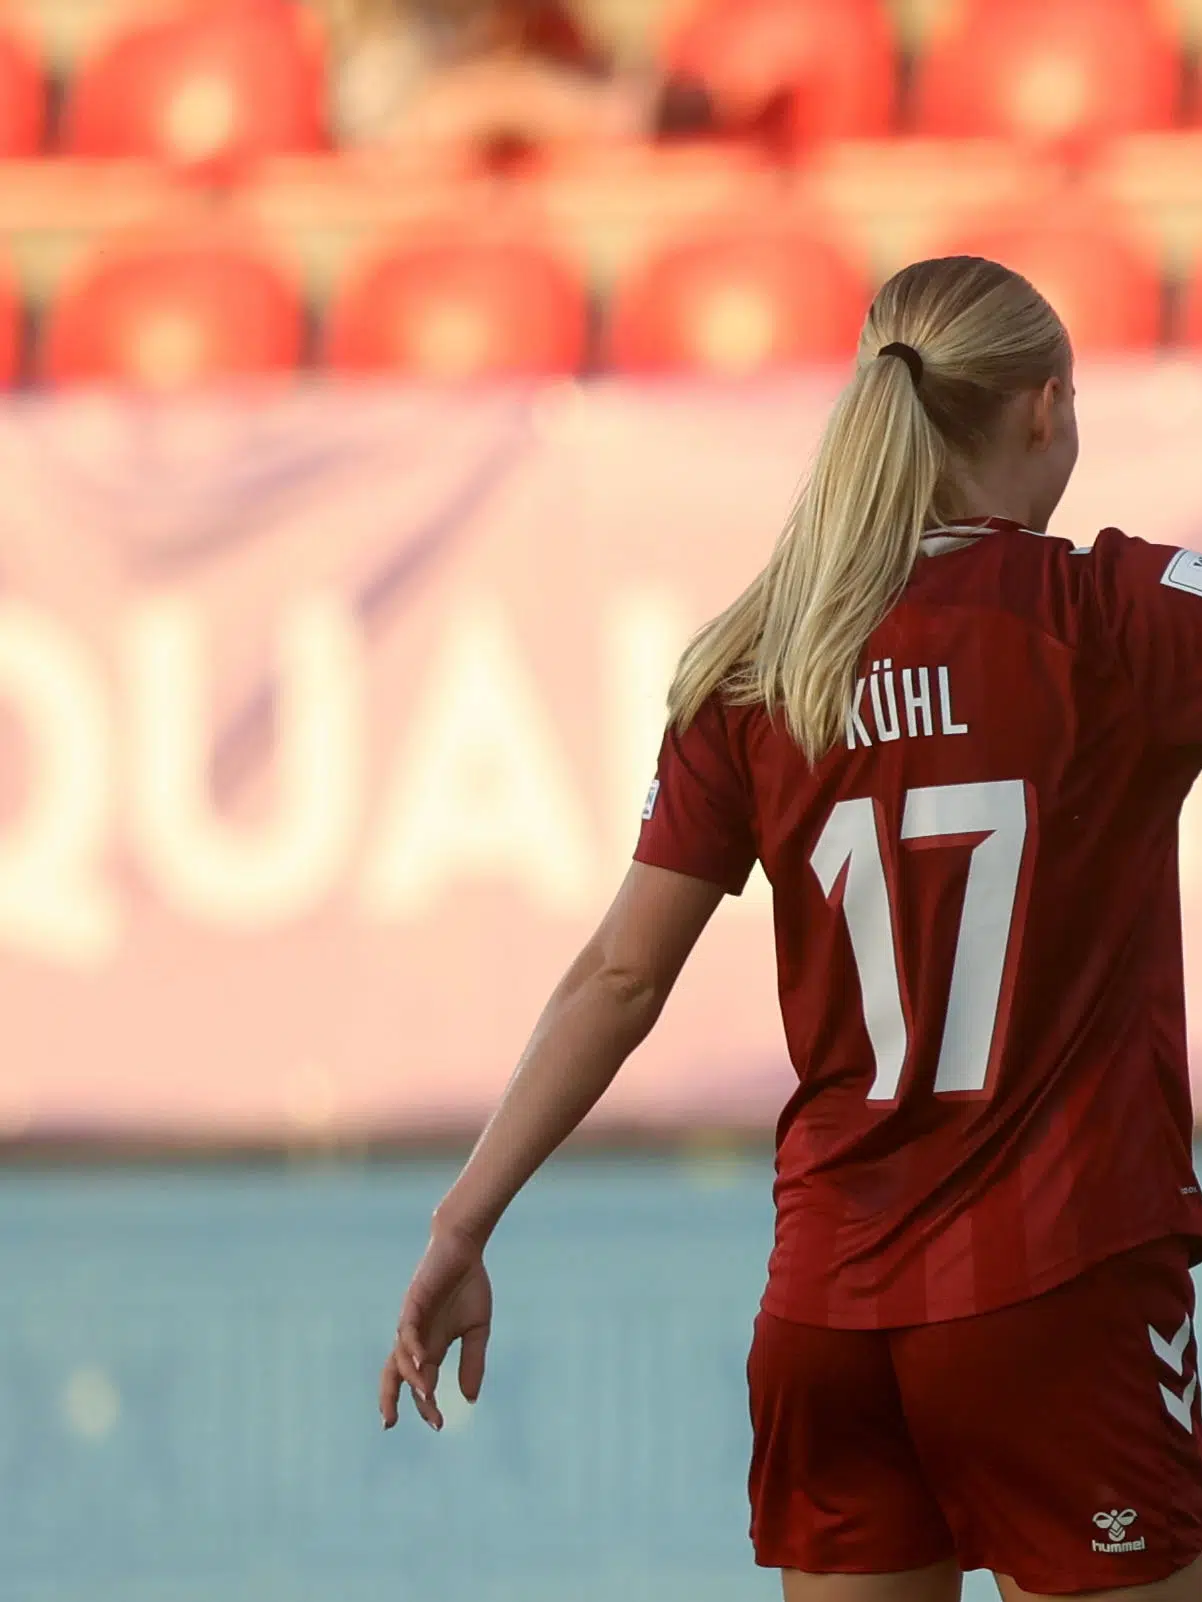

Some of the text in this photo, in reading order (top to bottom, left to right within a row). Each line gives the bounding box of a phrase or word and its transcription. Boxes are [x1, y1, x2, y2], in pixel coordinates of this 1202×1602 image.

[845, 658, 968, 750] KÜHL
[809, 779, 1031, 1104] 17
[1092, 1536, 1145, 1552] hummel
